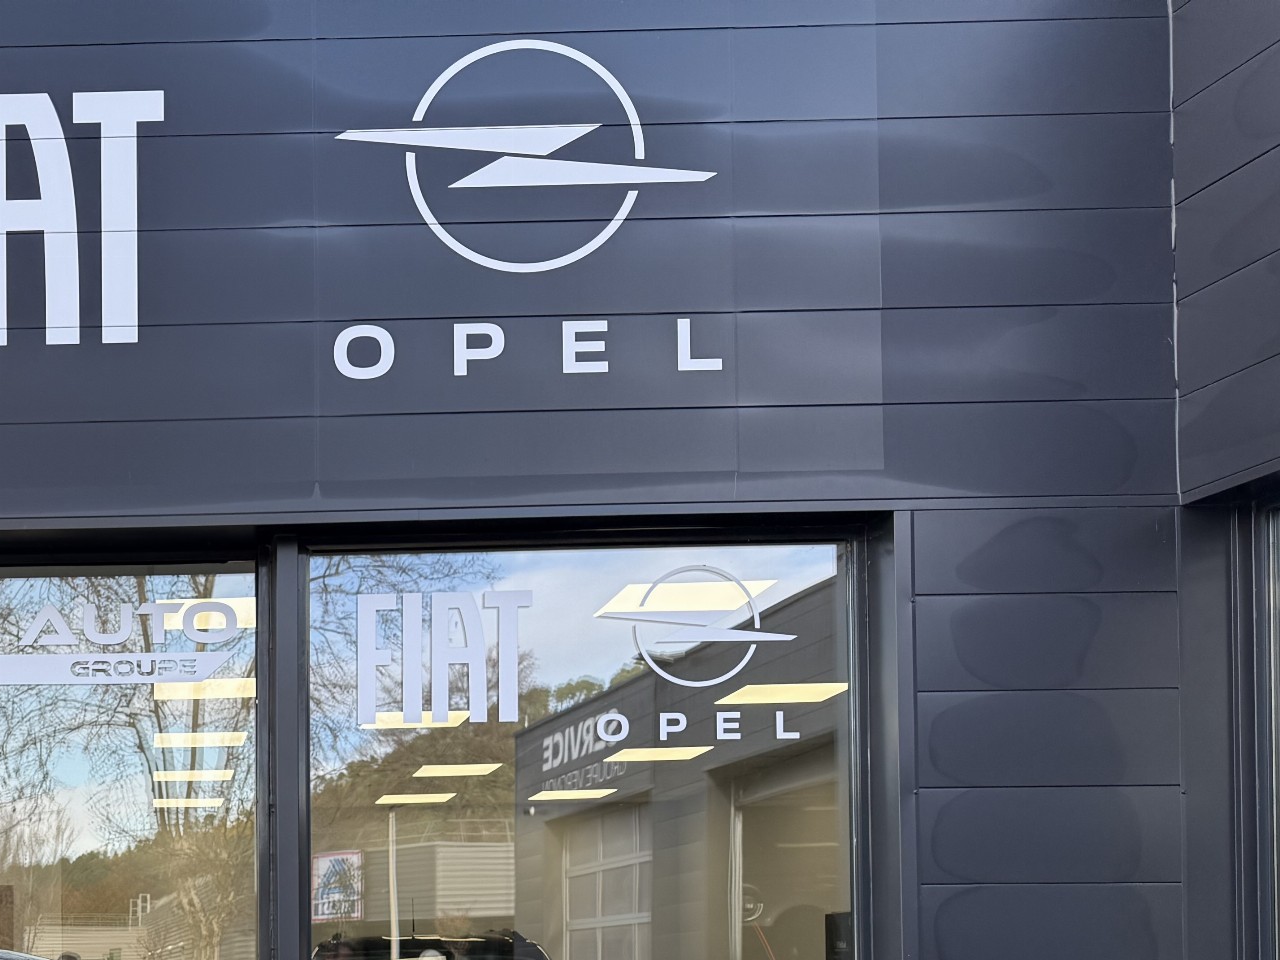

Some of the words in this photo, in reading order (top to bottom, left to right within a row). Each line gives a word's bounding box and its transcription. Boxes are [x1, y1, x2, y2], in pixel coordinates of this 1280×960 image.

[333, 319, 723, 380] OPEL
[19, 601, 238, 645] AUTO
[70, 658, 197, 677] GROUPE
[357, 590, 532, 724] FIAT
[596, 711, 800, 742] OPEL
